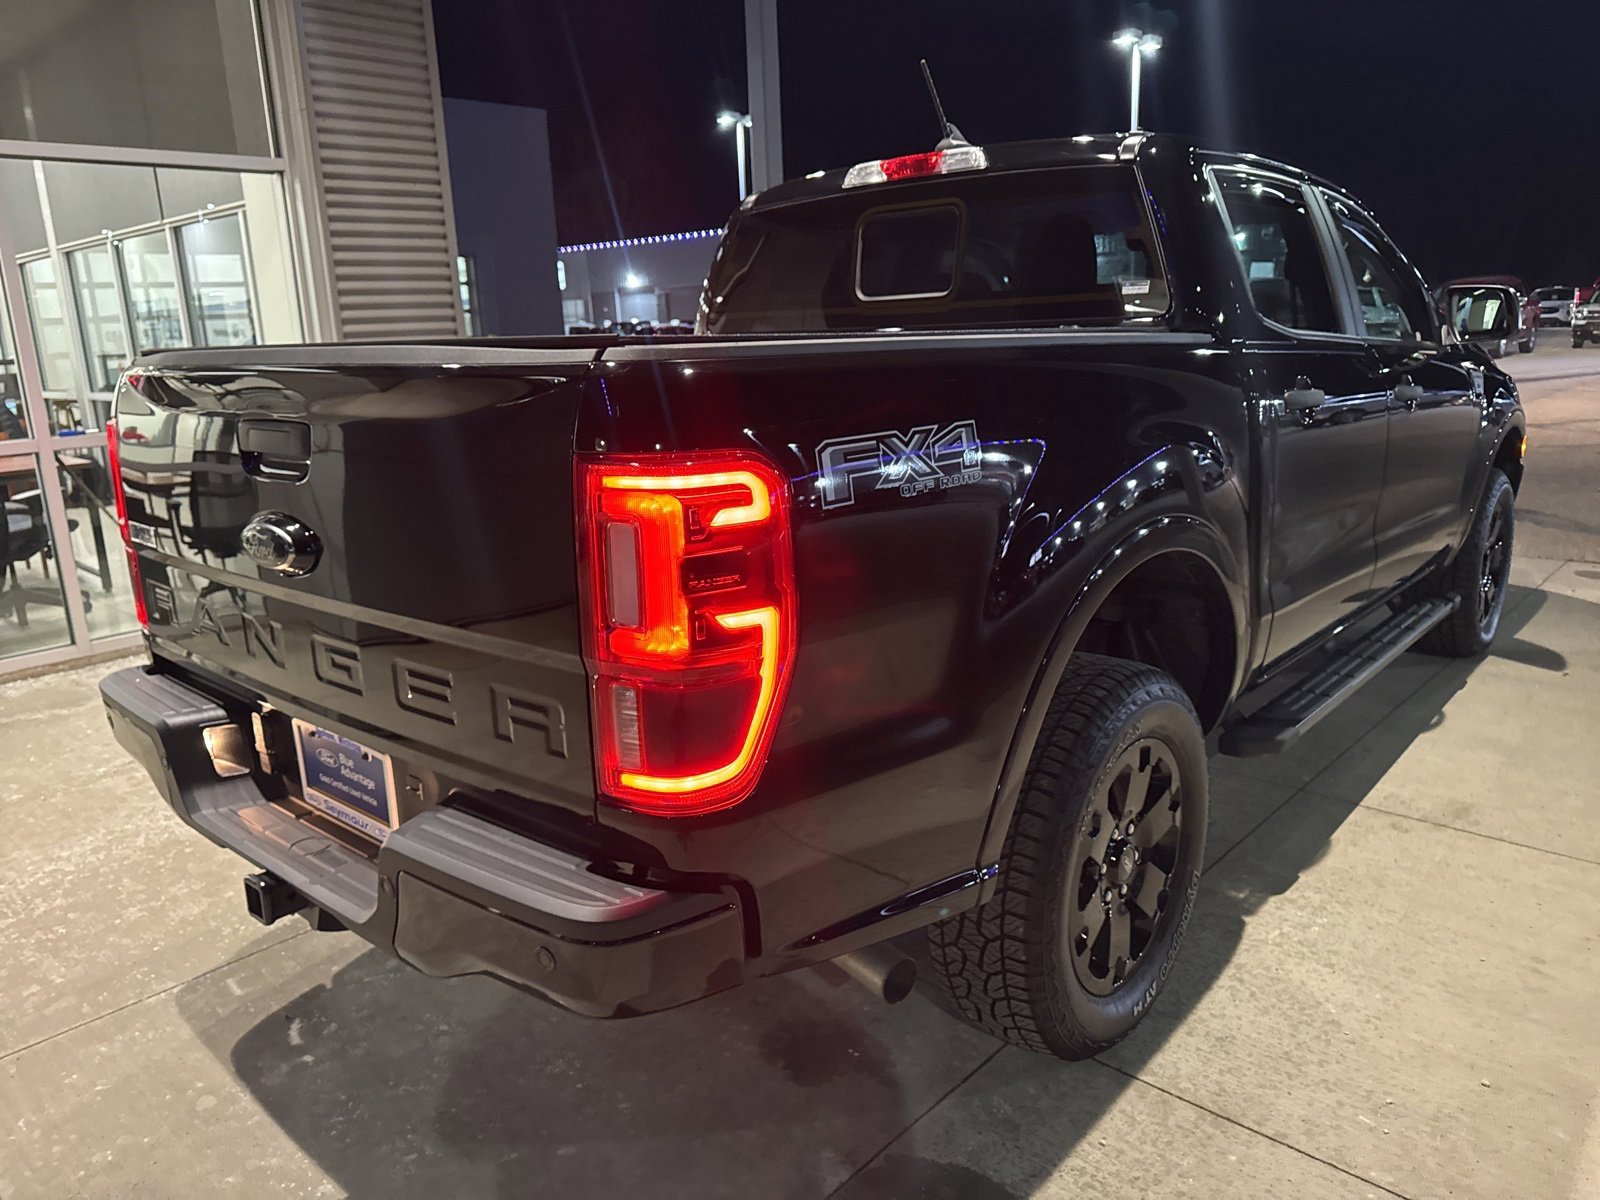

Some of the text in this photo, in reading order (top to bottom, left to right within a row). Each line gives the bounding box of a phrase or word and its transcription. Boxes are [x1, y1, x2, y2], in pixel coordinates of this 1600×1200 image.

[815, 420, 981, 509] FX4
[900, 471, 982, 497] OFF ROAD
[145, 577, 568, 760] RANGER
[339, 752, 354, 769] Blue
[341, 765, 376, 790] Advantage
[323, 799, 369, 830] Seymour
